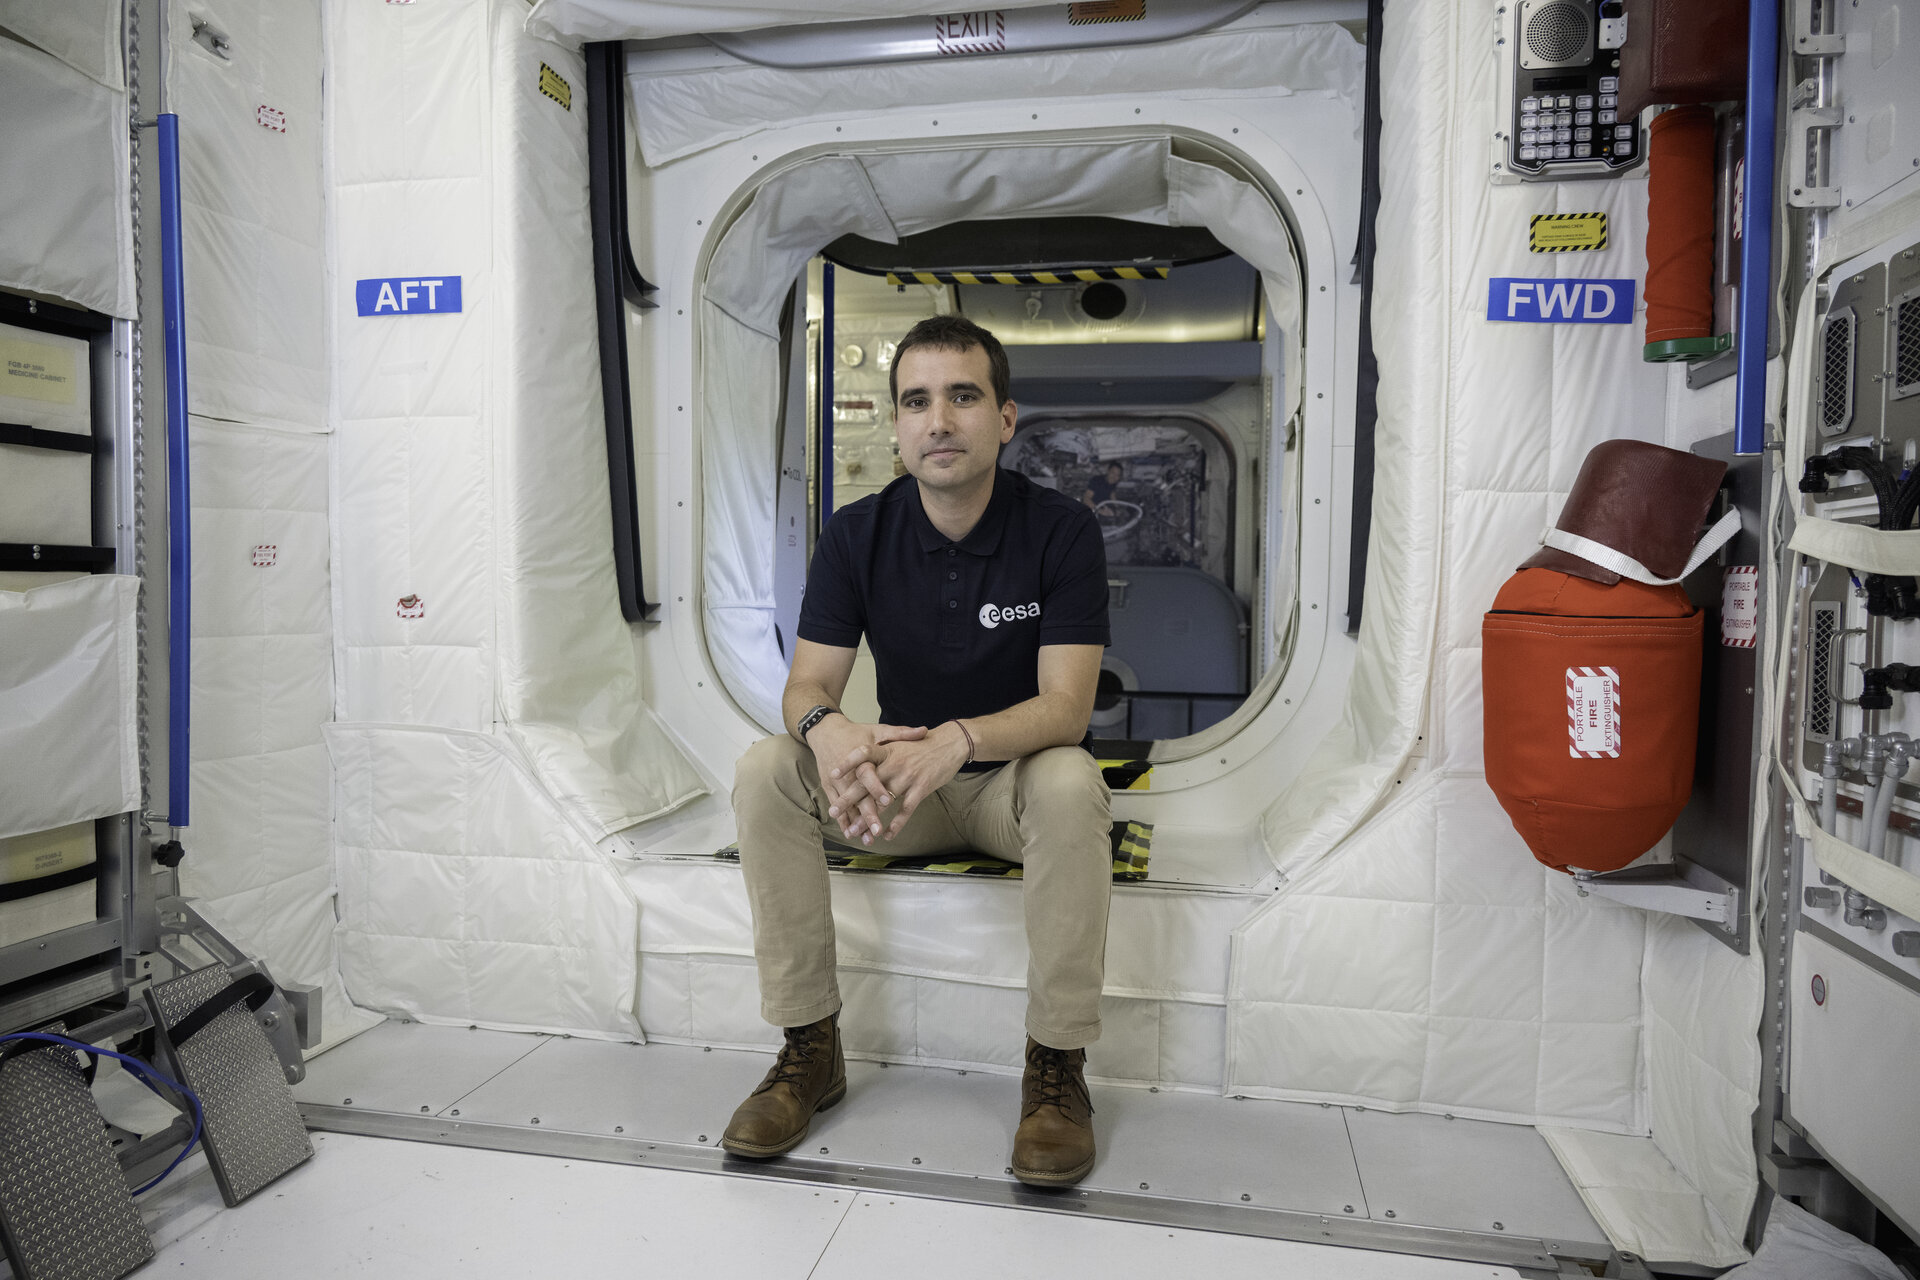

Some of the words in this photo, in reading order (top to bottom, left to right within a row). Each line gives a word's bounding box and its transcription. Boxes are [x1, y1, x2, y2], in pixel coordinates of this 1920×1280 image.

[374, 280, 443, 312] AFT
[1507, 282, 1616, 319] FWD
[8, 368, 39, 379] MEDICINE
[39, 373, 67, 383] CABINET
[1728, 581, 1751, 592] PORTABLE
[1001, 602, 1041, 622] esa
[1733, 599, 1745, 610] FIRE
[1725, 617, 1752, 629] EXTINGUISHER
[1575, 686, 1585, 742] PORTABLE
[1588, 699, 1598, 728] FIRE
[1602, 680, 1613, 747] EXTINGUISHER
